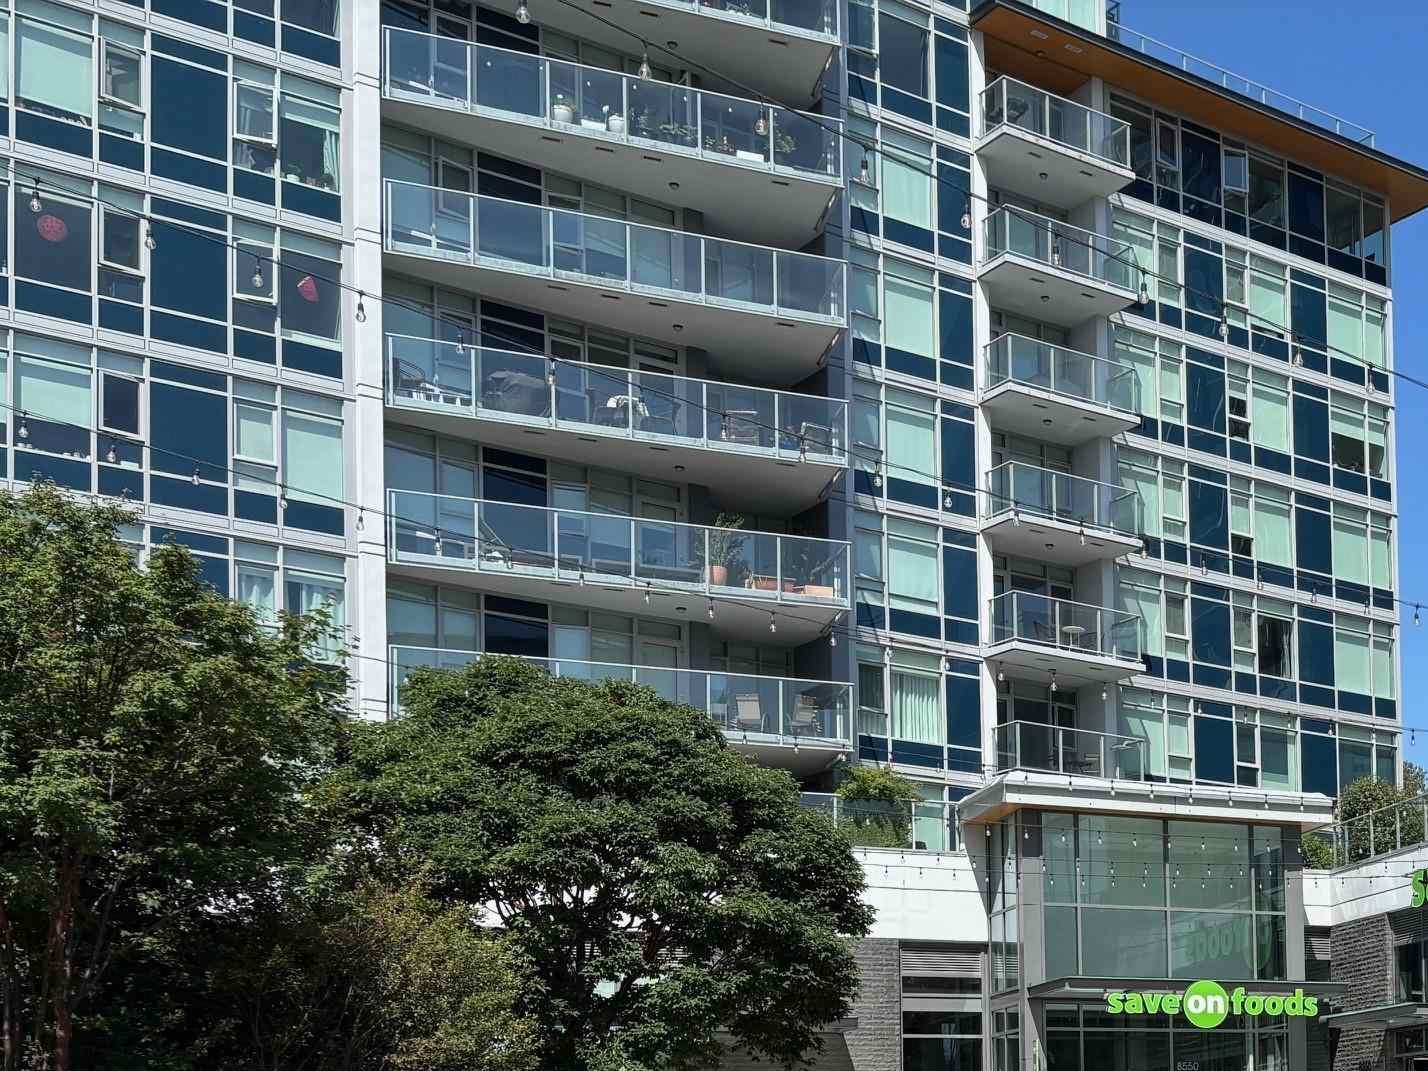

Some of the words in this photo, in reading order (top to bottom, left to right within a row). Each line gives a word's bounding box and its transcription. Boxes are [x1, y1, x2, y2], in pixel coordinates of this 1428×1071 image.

[1107, 993, 1180, 1014] save
[1187, 995, 1225, 1014] on
[1232, 987, 1319, 1017] foods
